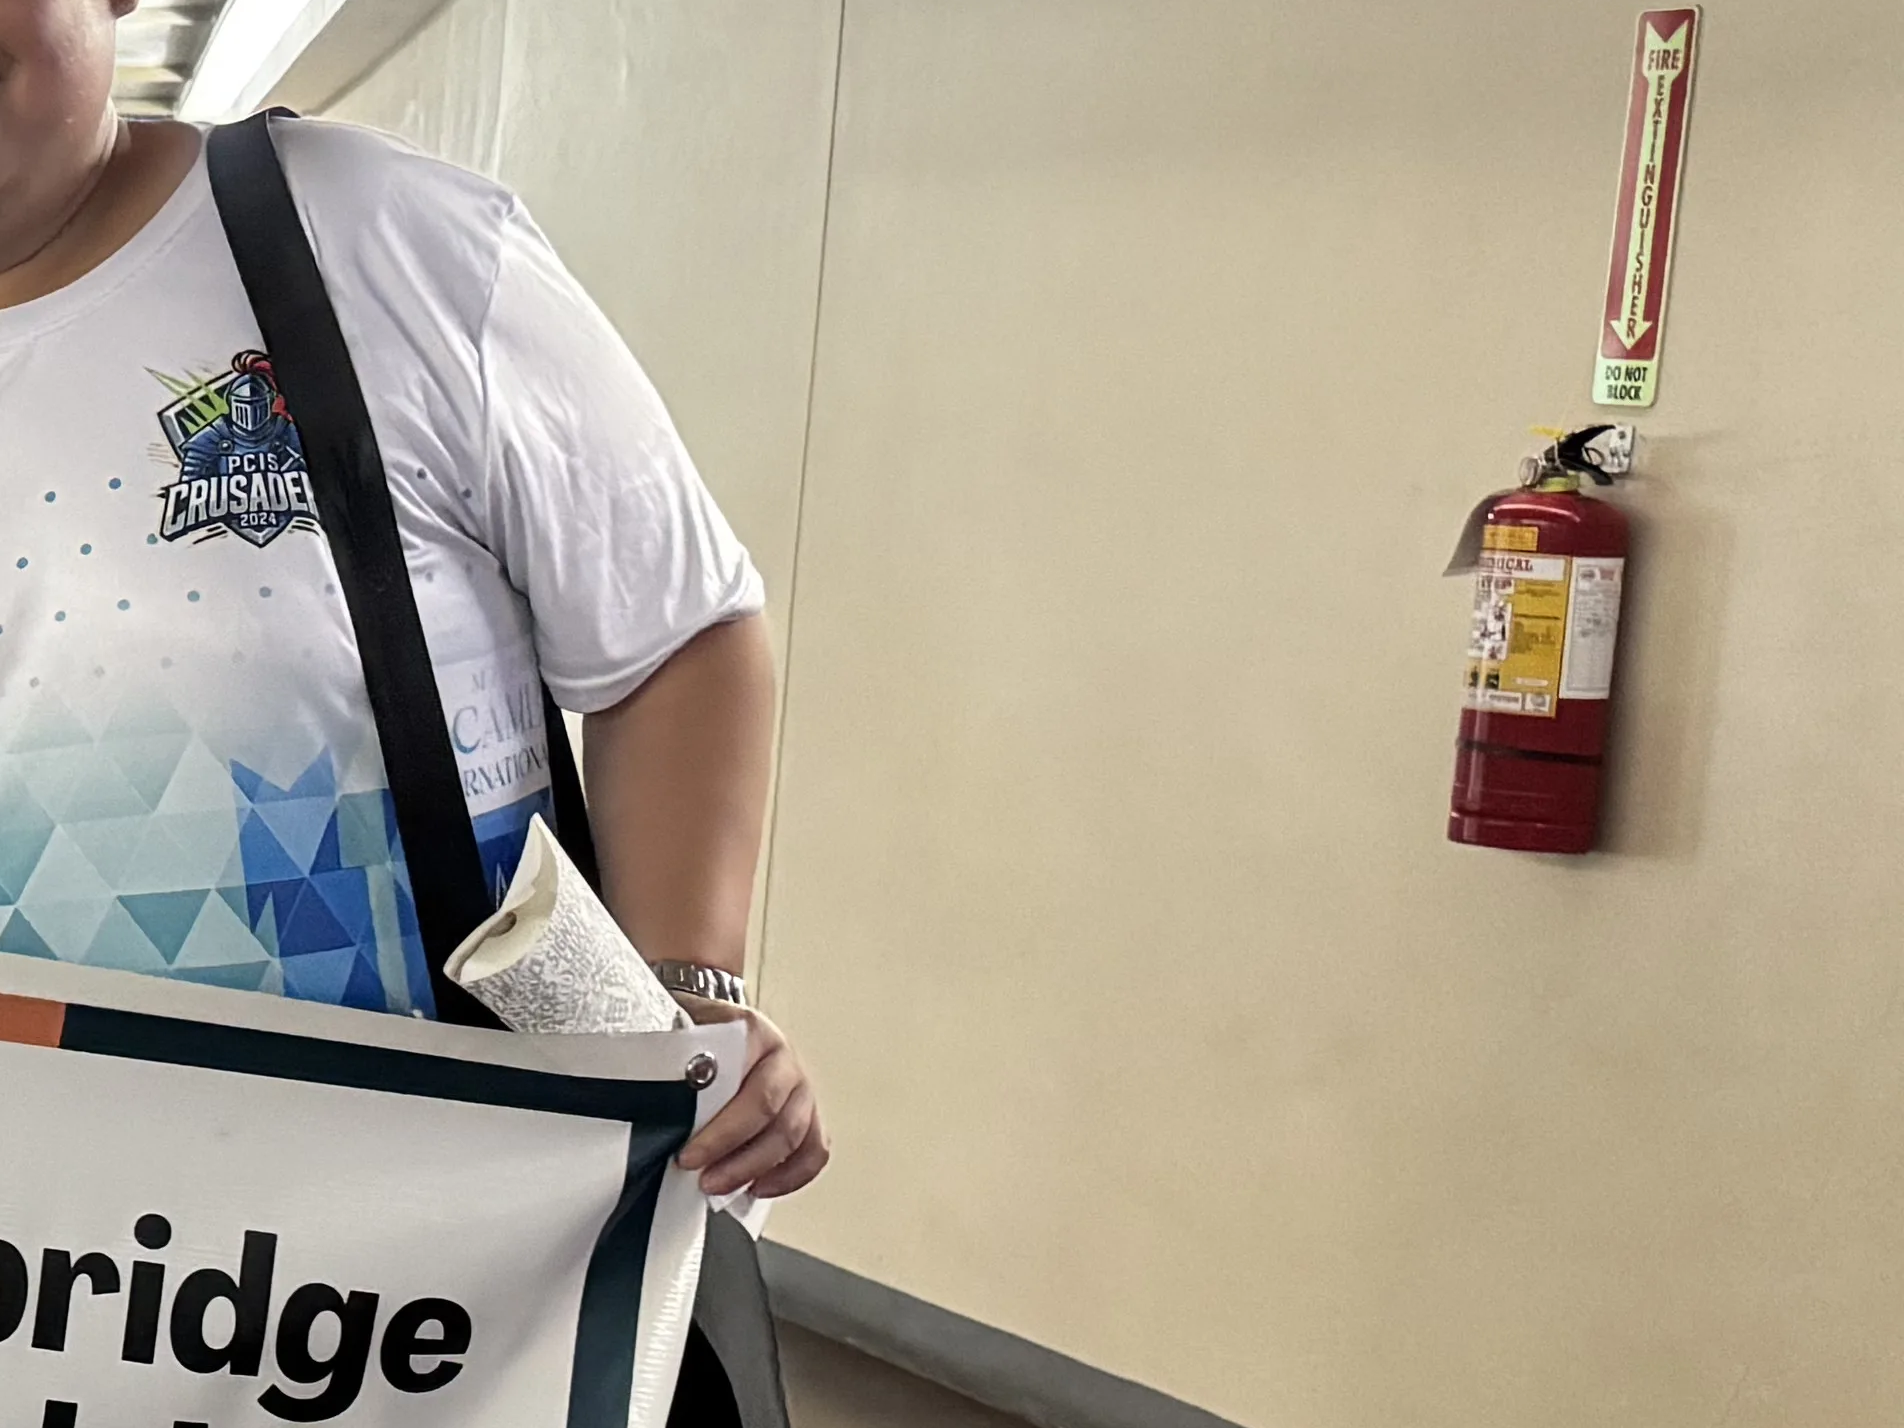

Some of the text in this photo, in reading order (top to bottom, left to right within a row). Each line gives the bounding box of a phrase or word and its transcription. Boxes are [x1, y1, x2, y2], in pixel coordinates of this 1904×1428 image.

[1647, 48, 1682, 71] FIRE
[1625, 74, 1667, 339] EXTINGUISHER
[1605, 365, 1648, 383] DO NOT
[1606, 384, 1643, 401] BLOCK
[228, 454, 278, 474] PCIS
[240, 512, 277, 527] 2024
